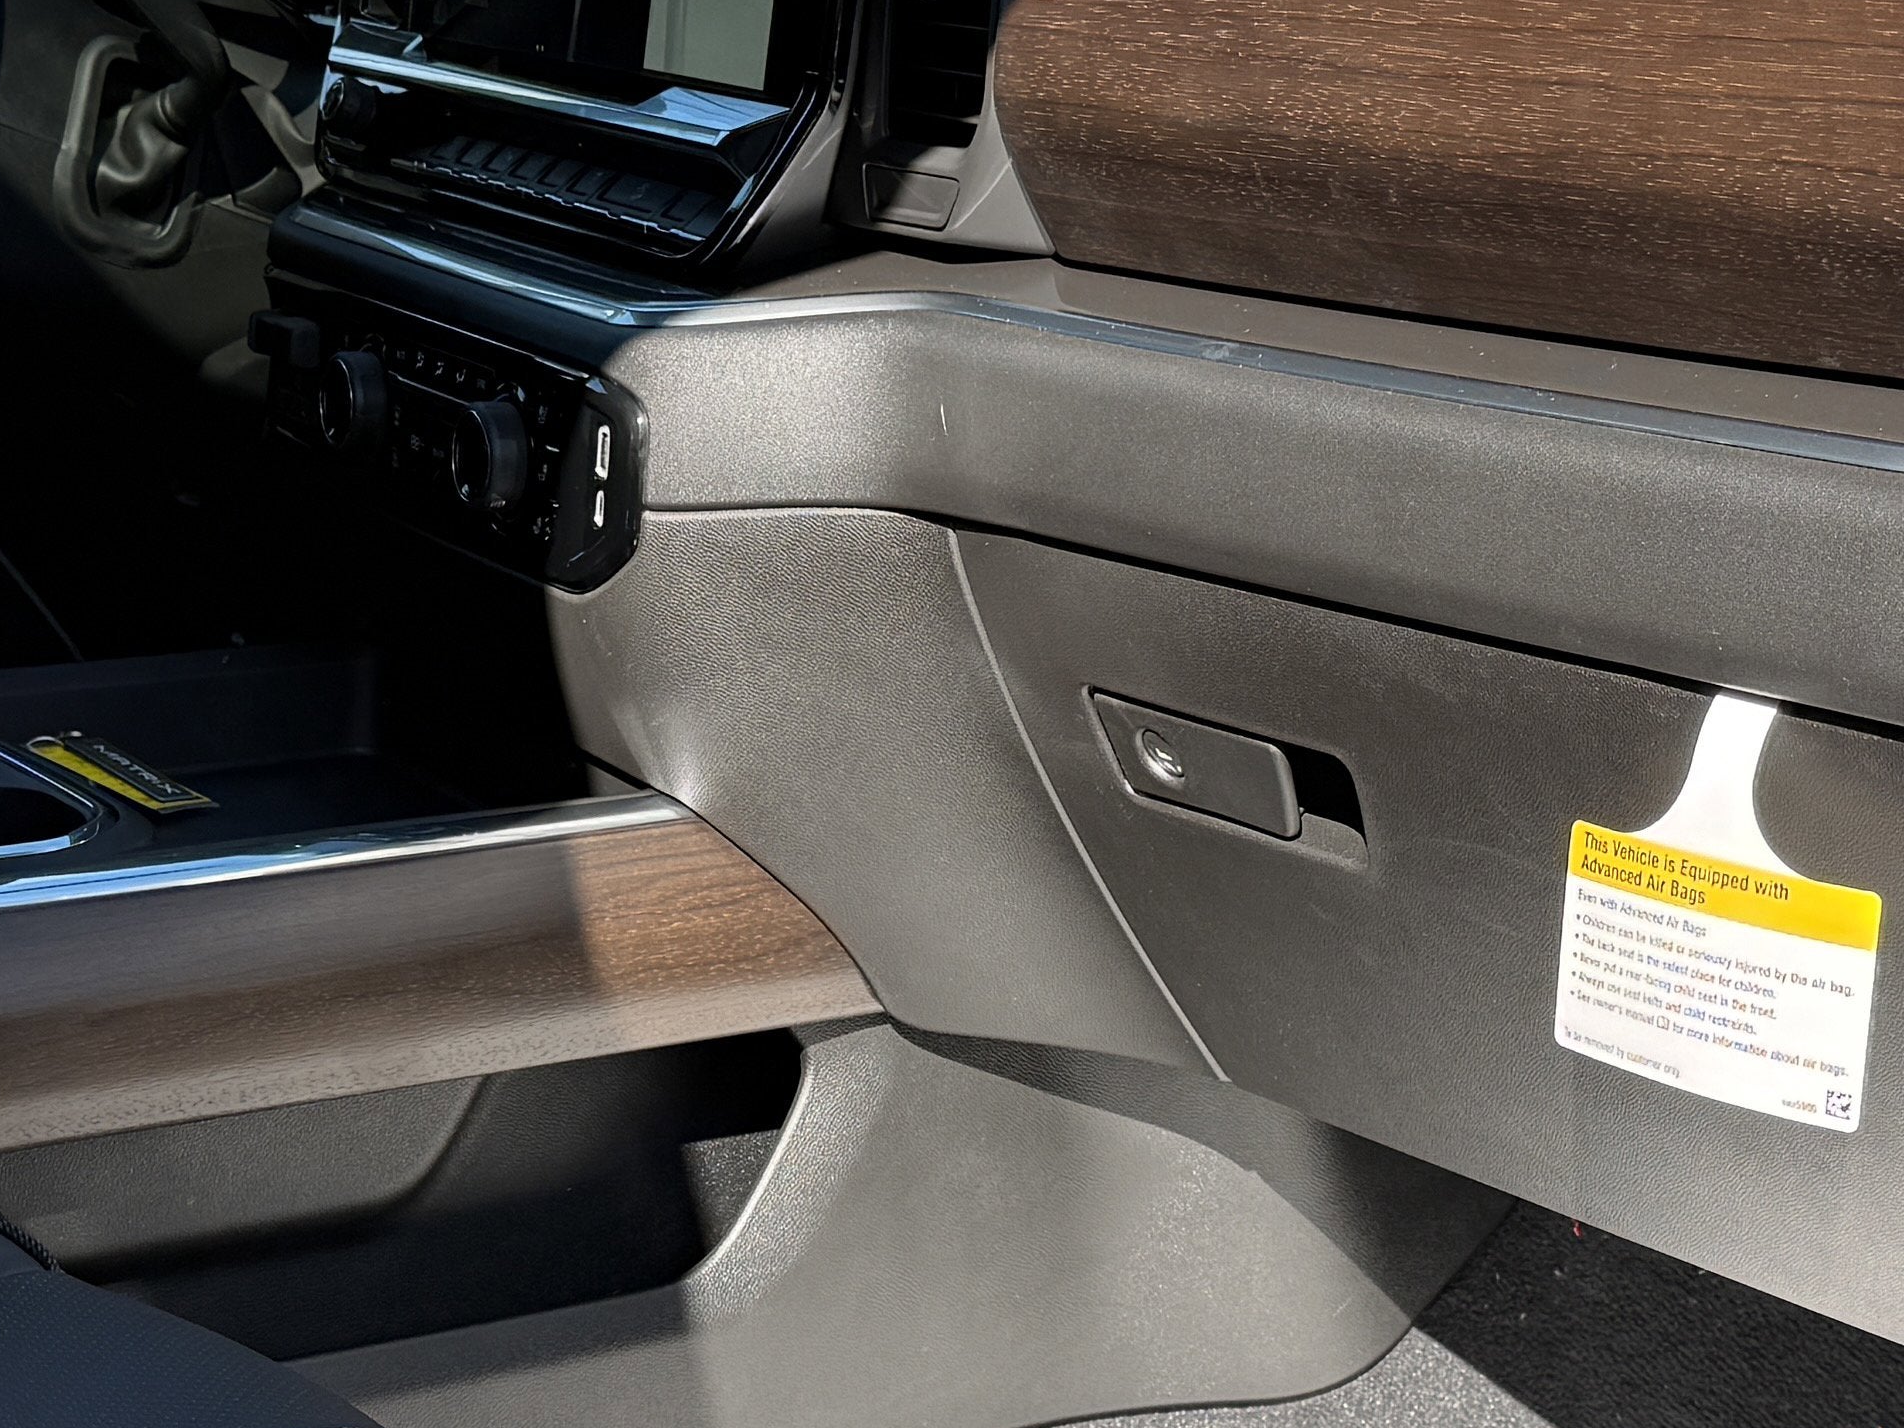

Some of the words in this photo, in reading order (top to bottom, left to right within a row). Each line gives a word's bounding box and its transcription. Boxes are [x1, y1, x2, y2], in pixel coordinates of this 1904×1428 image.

[1581, 853, 1643, 887] Advanced
[1646, 874, 1667, 893] Air
[1670, 879, 1706, 906] Bags
[1584, 831, 1609, 854] This
[1612, 839, 1659, 869] Vehicle
[1663, 853, 1676, 873] is
[1680, 858, 1749, 891] Equipped
[1754, 879, 1790, 901] with
